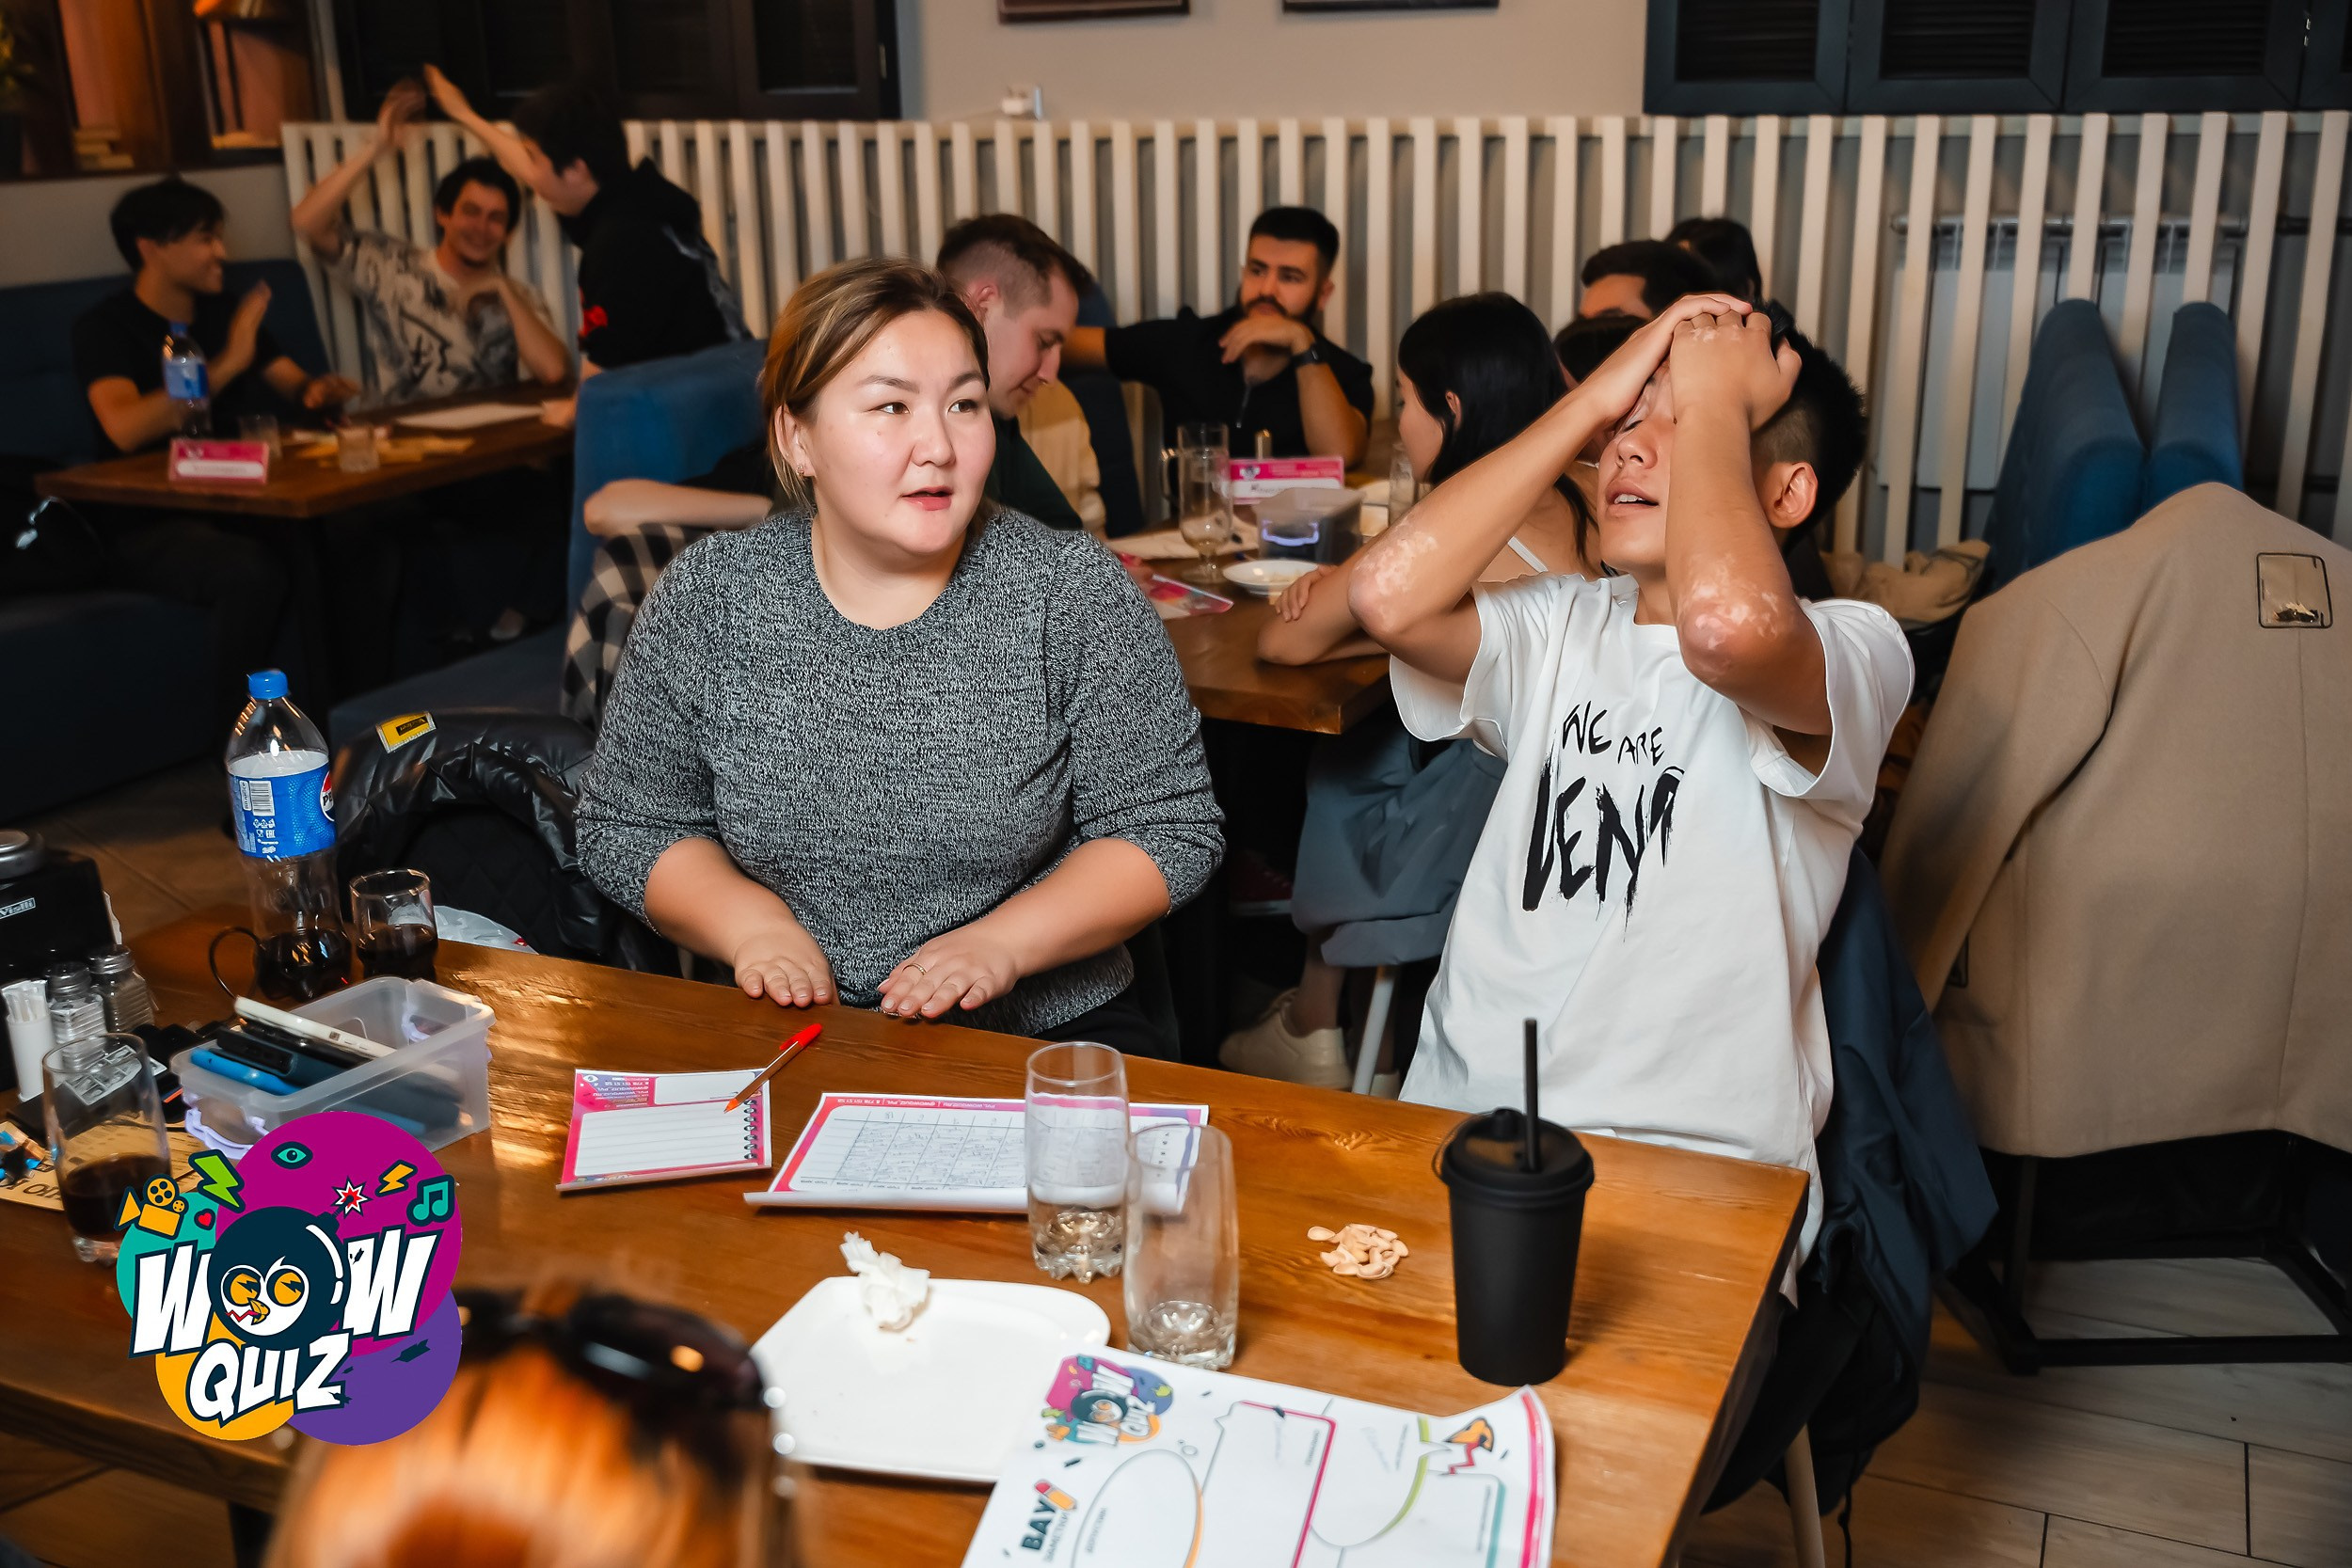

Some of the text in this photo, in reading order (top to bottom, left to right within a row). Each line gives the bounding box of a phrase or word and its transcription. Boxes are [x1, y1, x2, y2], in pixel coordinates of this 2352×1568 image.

[1562, 700, 1665, 767] WE ARE
[323, 792, 333, 806] PE
